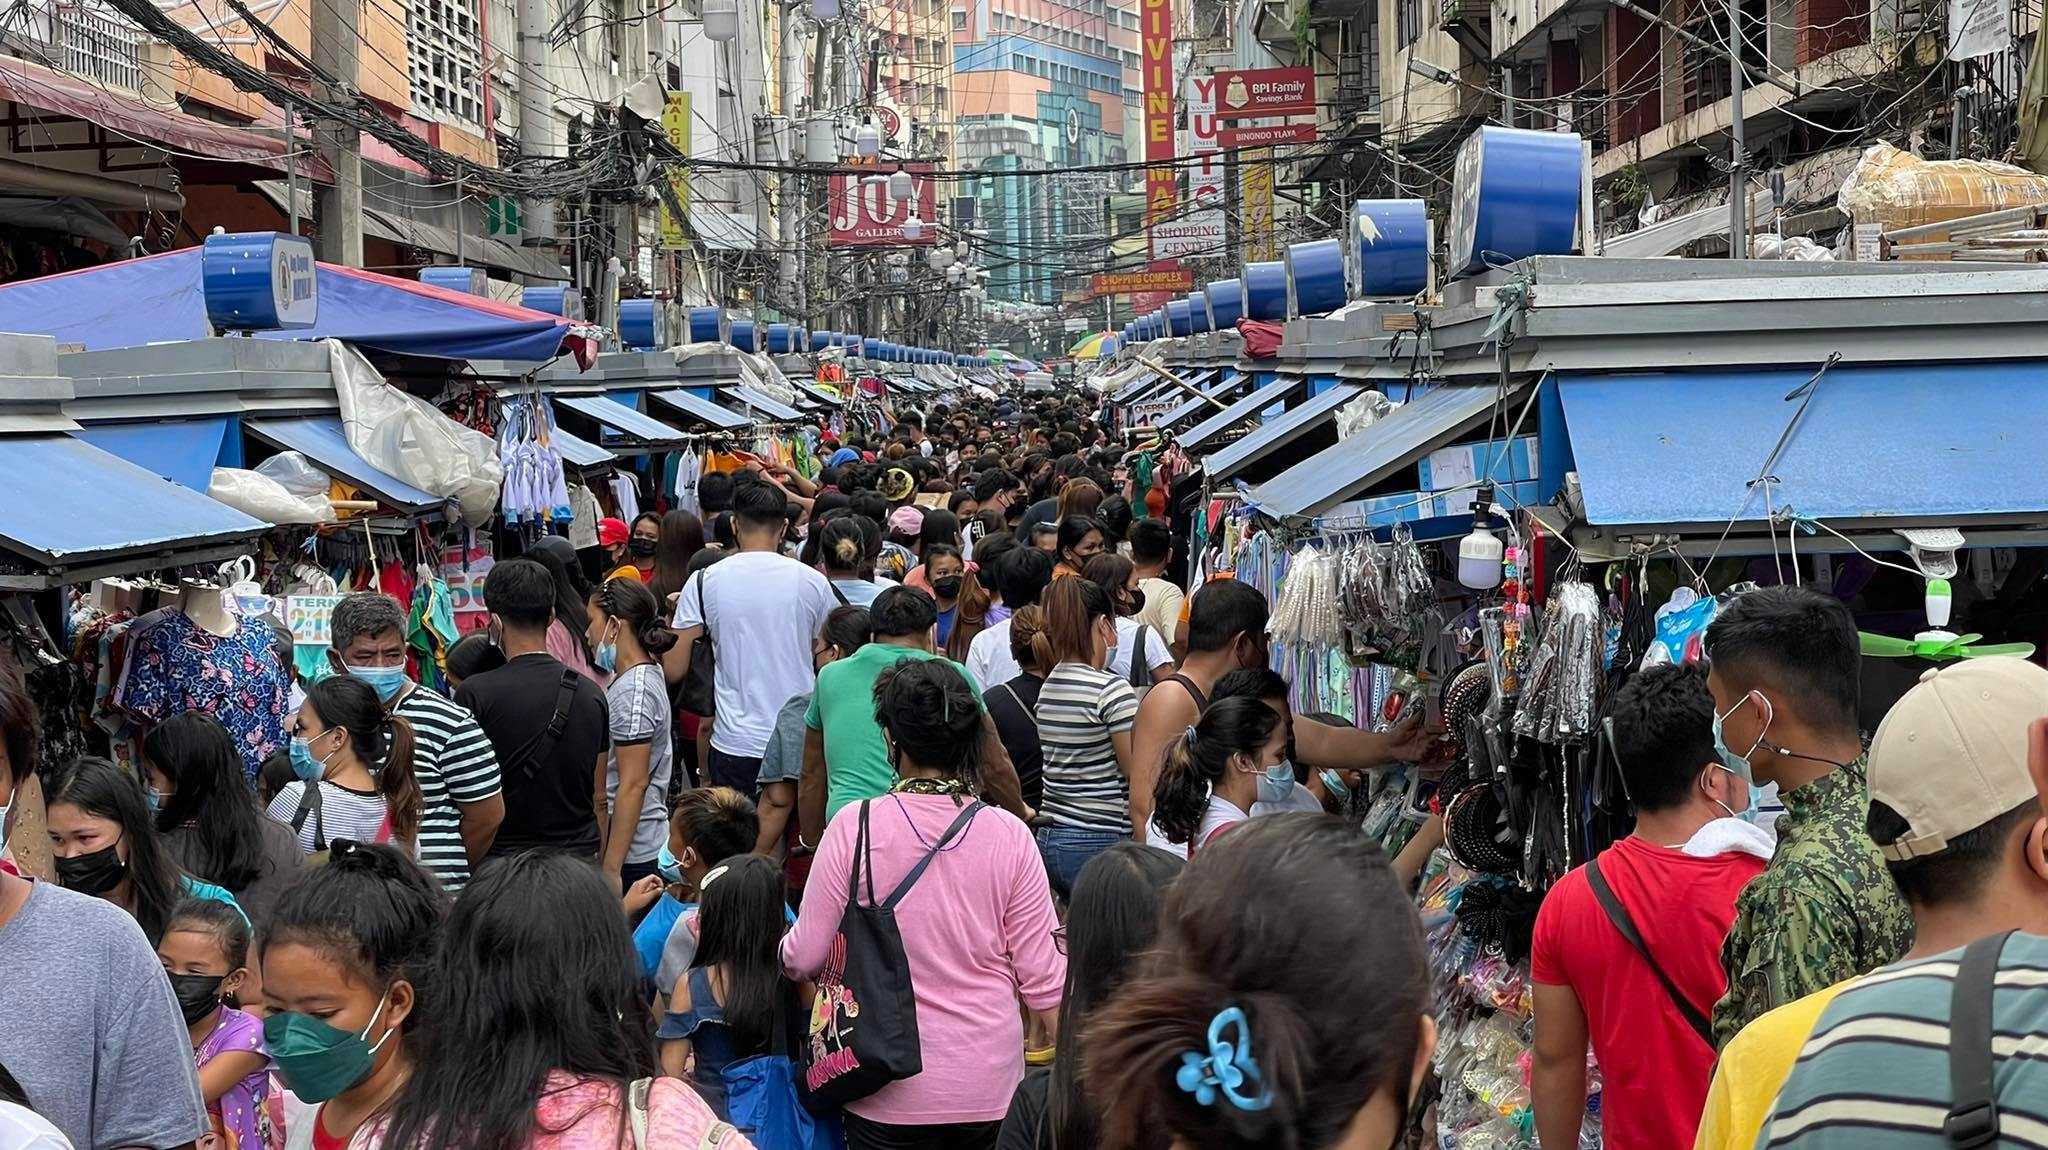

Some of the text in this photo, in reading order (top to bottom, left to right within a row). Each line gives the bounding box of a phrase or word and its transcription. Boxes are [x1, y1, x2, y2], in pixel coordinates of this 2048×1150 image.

[1252, 82, 1305, 95] BPI Family
[1256, 92, 1303, 104] Savings Bank
[1235, 130, 1297, 142] BINONDO YLAYA
[834, 174, 924, 231] JOY
[1157, 225, 1220, 238] SHOPPING
[1163, 239, 1214, 254] CENTER
[1101, 271, 1183, 286] SHOPPING COMPLEX
[293, 597, 341, 608] TERN
